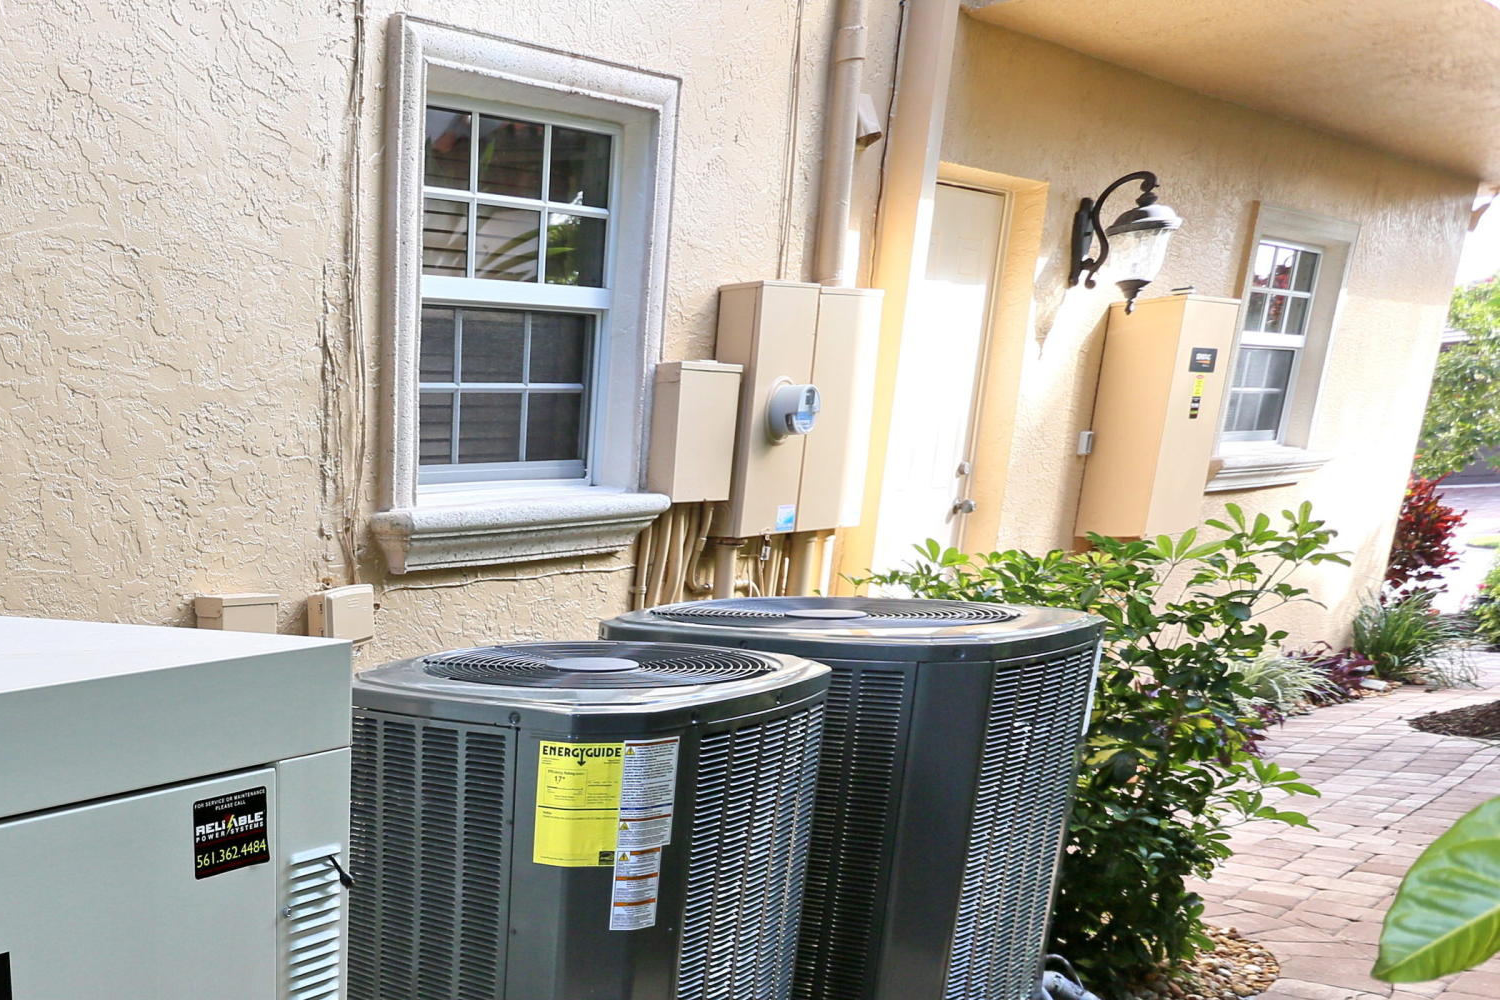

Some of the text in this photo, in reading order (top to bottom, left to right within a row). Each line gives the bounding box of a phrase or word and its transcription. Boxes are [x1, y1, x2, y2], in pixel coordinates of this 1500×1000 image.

[542, 745, 622, 760] ENERGYGUIDE
[194, 802, 204, 810] FOR
[205, 798, 225, 807] SERVICE
[233, 788, 265, 800] MAINTENANCE
[215, 802, 233, 811] PLEASE
[195, 811, 264, 837] RELIABLE
[195, 821, 264, 843] POWER SYSTEMS
[196, 838, 267, 869] 561.362.4484
